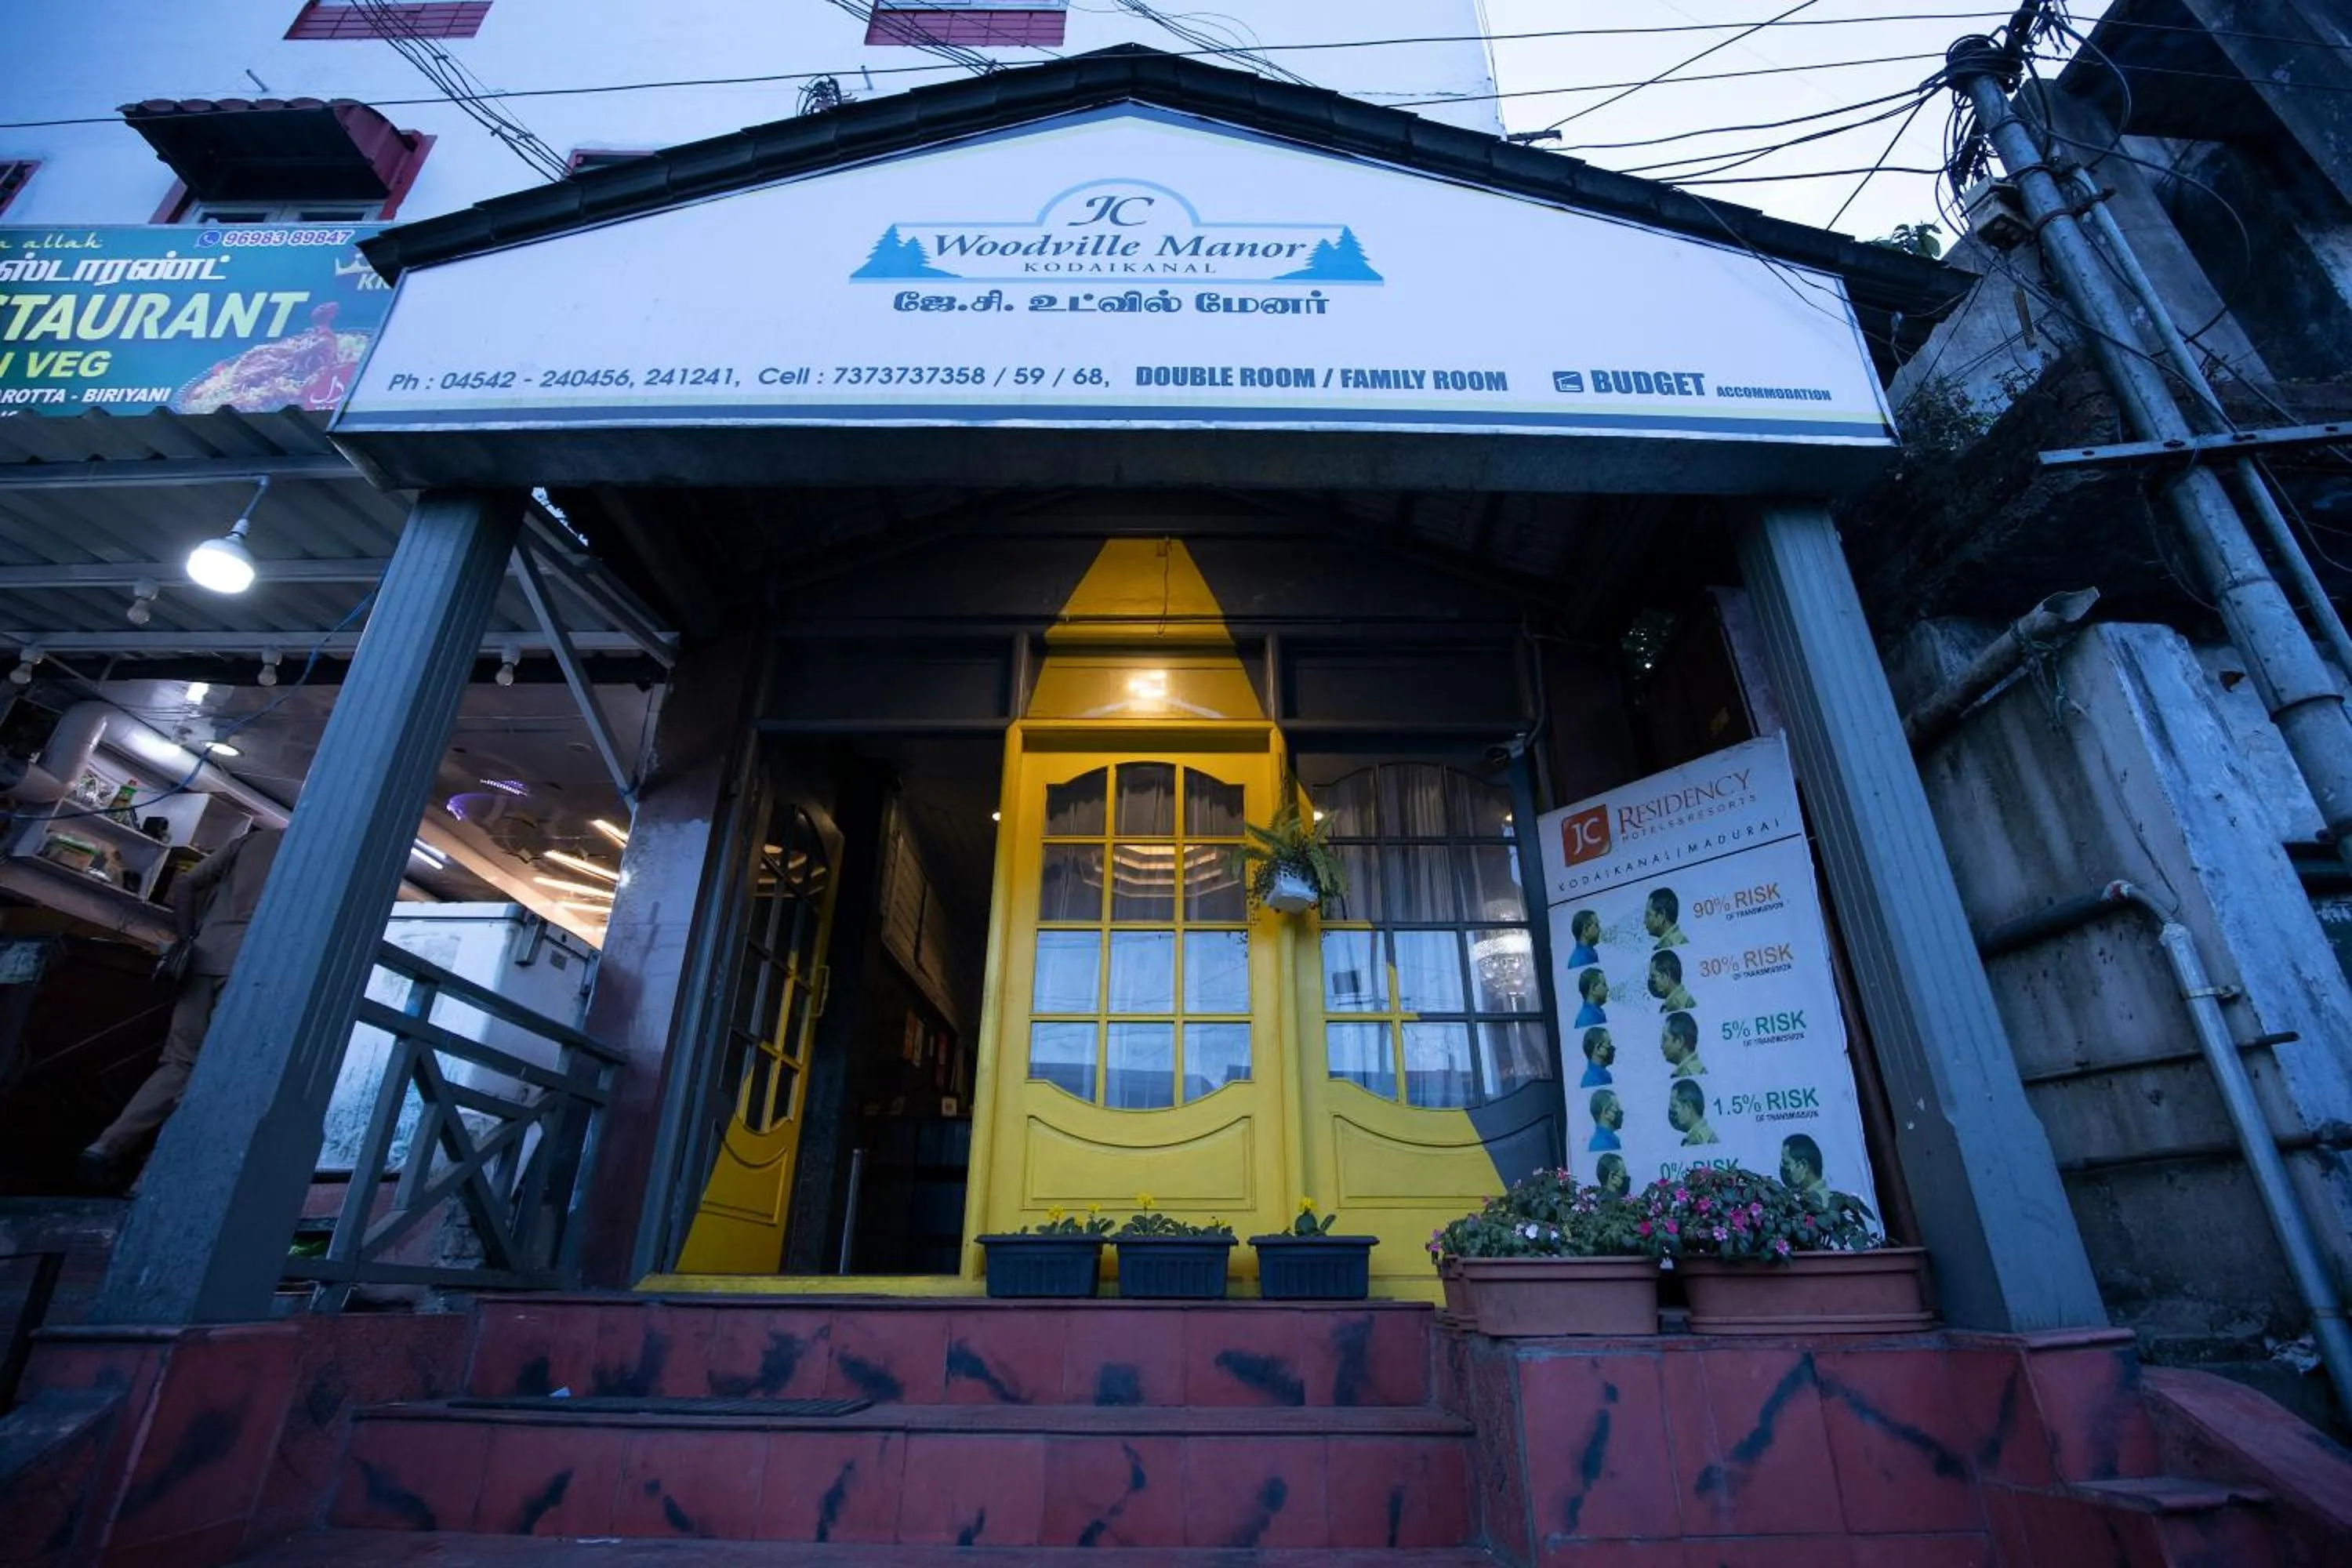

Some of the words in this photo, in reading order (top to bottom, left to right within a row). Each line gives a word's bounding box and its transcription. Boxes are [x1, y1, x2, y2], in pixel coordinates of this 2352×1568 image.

[1067, 195, 1155, 227] JC
[224, 230, 285, 247] 96983
[288, 229, 354, 246] 89847
[934, 234, 1141, 259] Woodville
[1154, 234, 1306, 260] Manor
[1024, 263, 1217, 274] KODAIKANAL
[26, 350, 112, 378] VEG
[0, 389, 66, 404] ROTTA
[82, 387, 172, 403] BIRIYANI
[388, 373, 419, 391] Ph
[440, 371, 517, 390] 04542
[539, 369, 634, 389] 240456,
[644, 368, 741, 387] 241241,
[758, 367, 810, 386] Cell
[833, 367, 985, 386] 7373737358
[1013, 367, 1045, 386] 59
[1073, 368, 1110, 389] 68,
[1135, 366, 1233, 387] DOUBLE
[1240, 367, 1316, 388] ROOM
[1340, 368, 1426, 390] FAMILY
[1433, 370, 1509, 391] ROOM
[1590, 369, 1705, 397] BUDGET
[1716, 385, 1832, 401] ACCOMMODATION
[1570, 817, 1602, 855] JC
[1693, 895, 1730, 918] 90%
[1734, 882, 1780, 908] RISK
[1700, 956, 1740, 978] 30%
[1744, 943, 1794, 968] RISK
[1722, 1021, 1751, 1040] 5%
[1755, 1010, 1806, 1035] RISK
[1713, 1094, 1762, 1116] 1.5%
[1766, 1087, 1819, 1111] RISK
